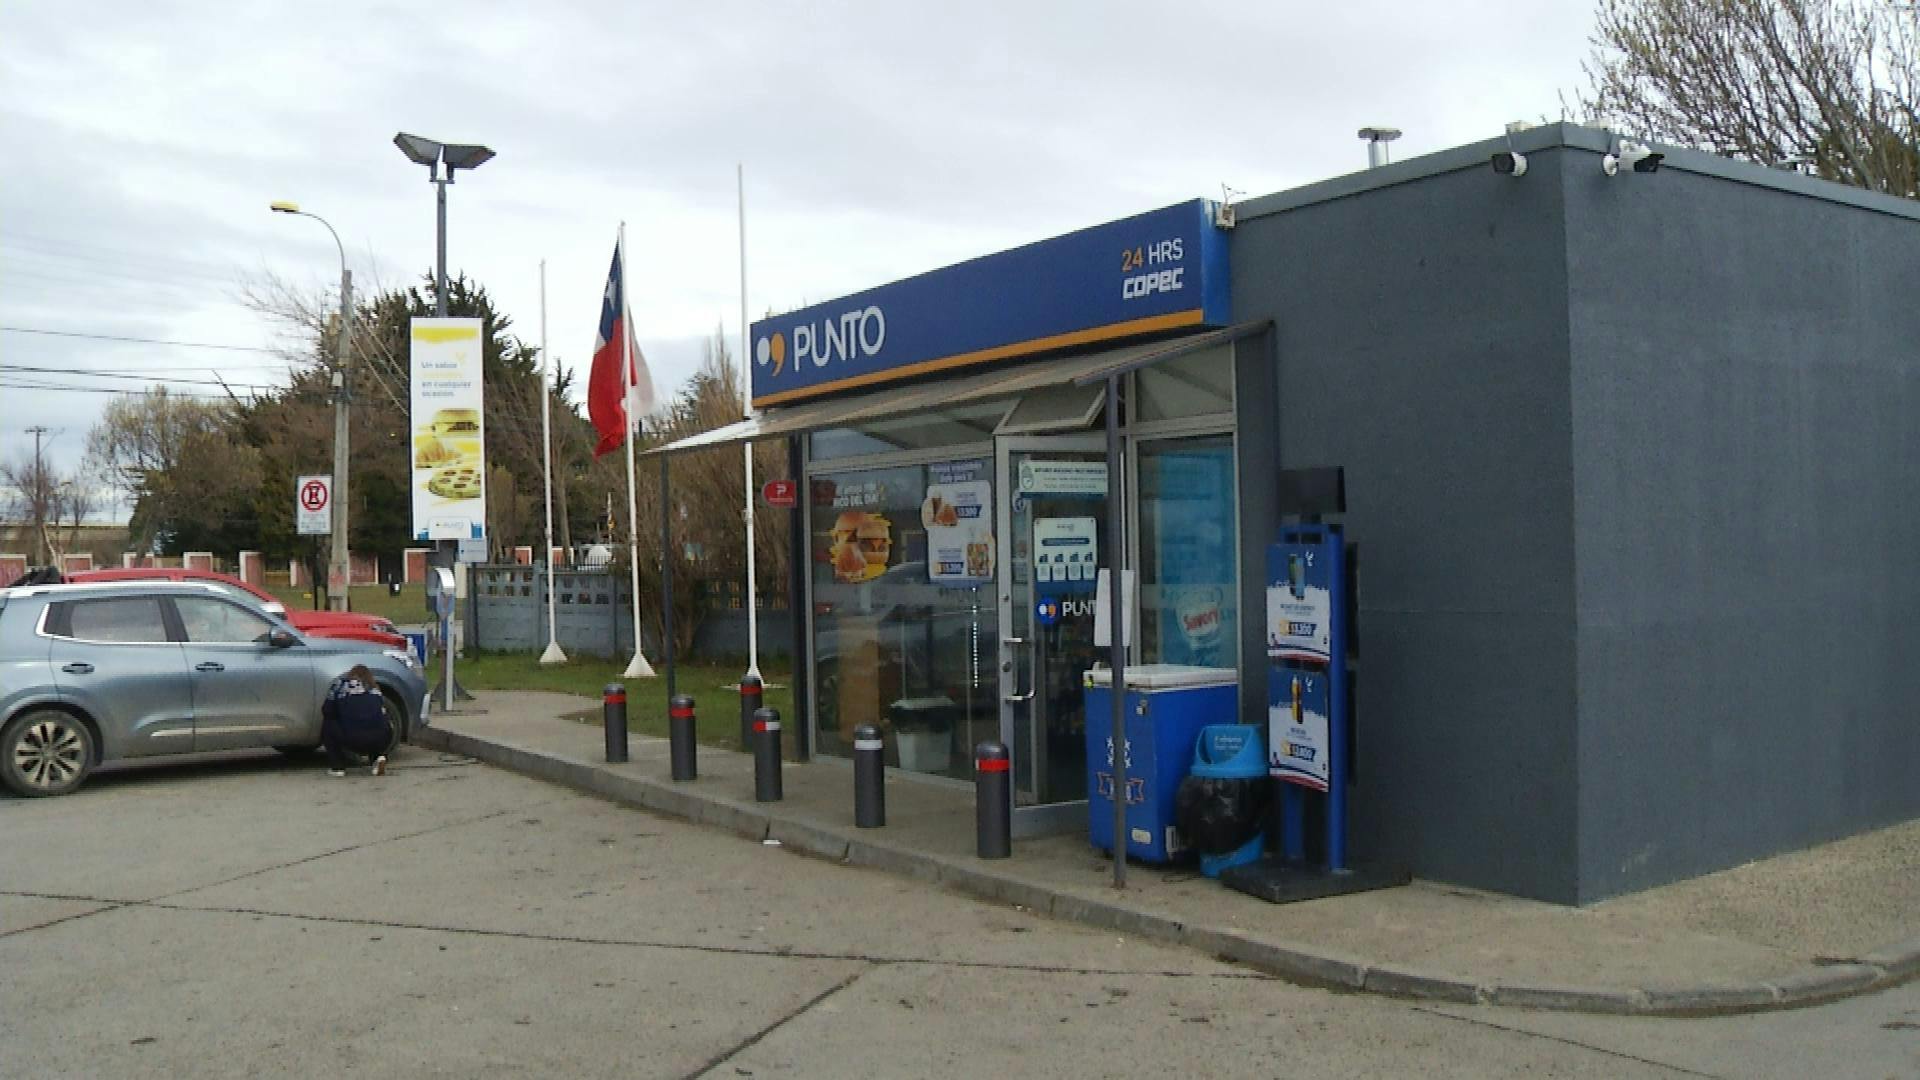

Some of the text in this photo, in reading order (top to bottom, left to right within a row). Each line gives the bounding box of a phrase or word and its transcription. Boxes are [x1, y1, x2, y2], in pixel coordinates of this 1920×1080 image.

[1121, 237, 1184, 272] 24 HRS
[793, 305, 885, 373] PUNTO
